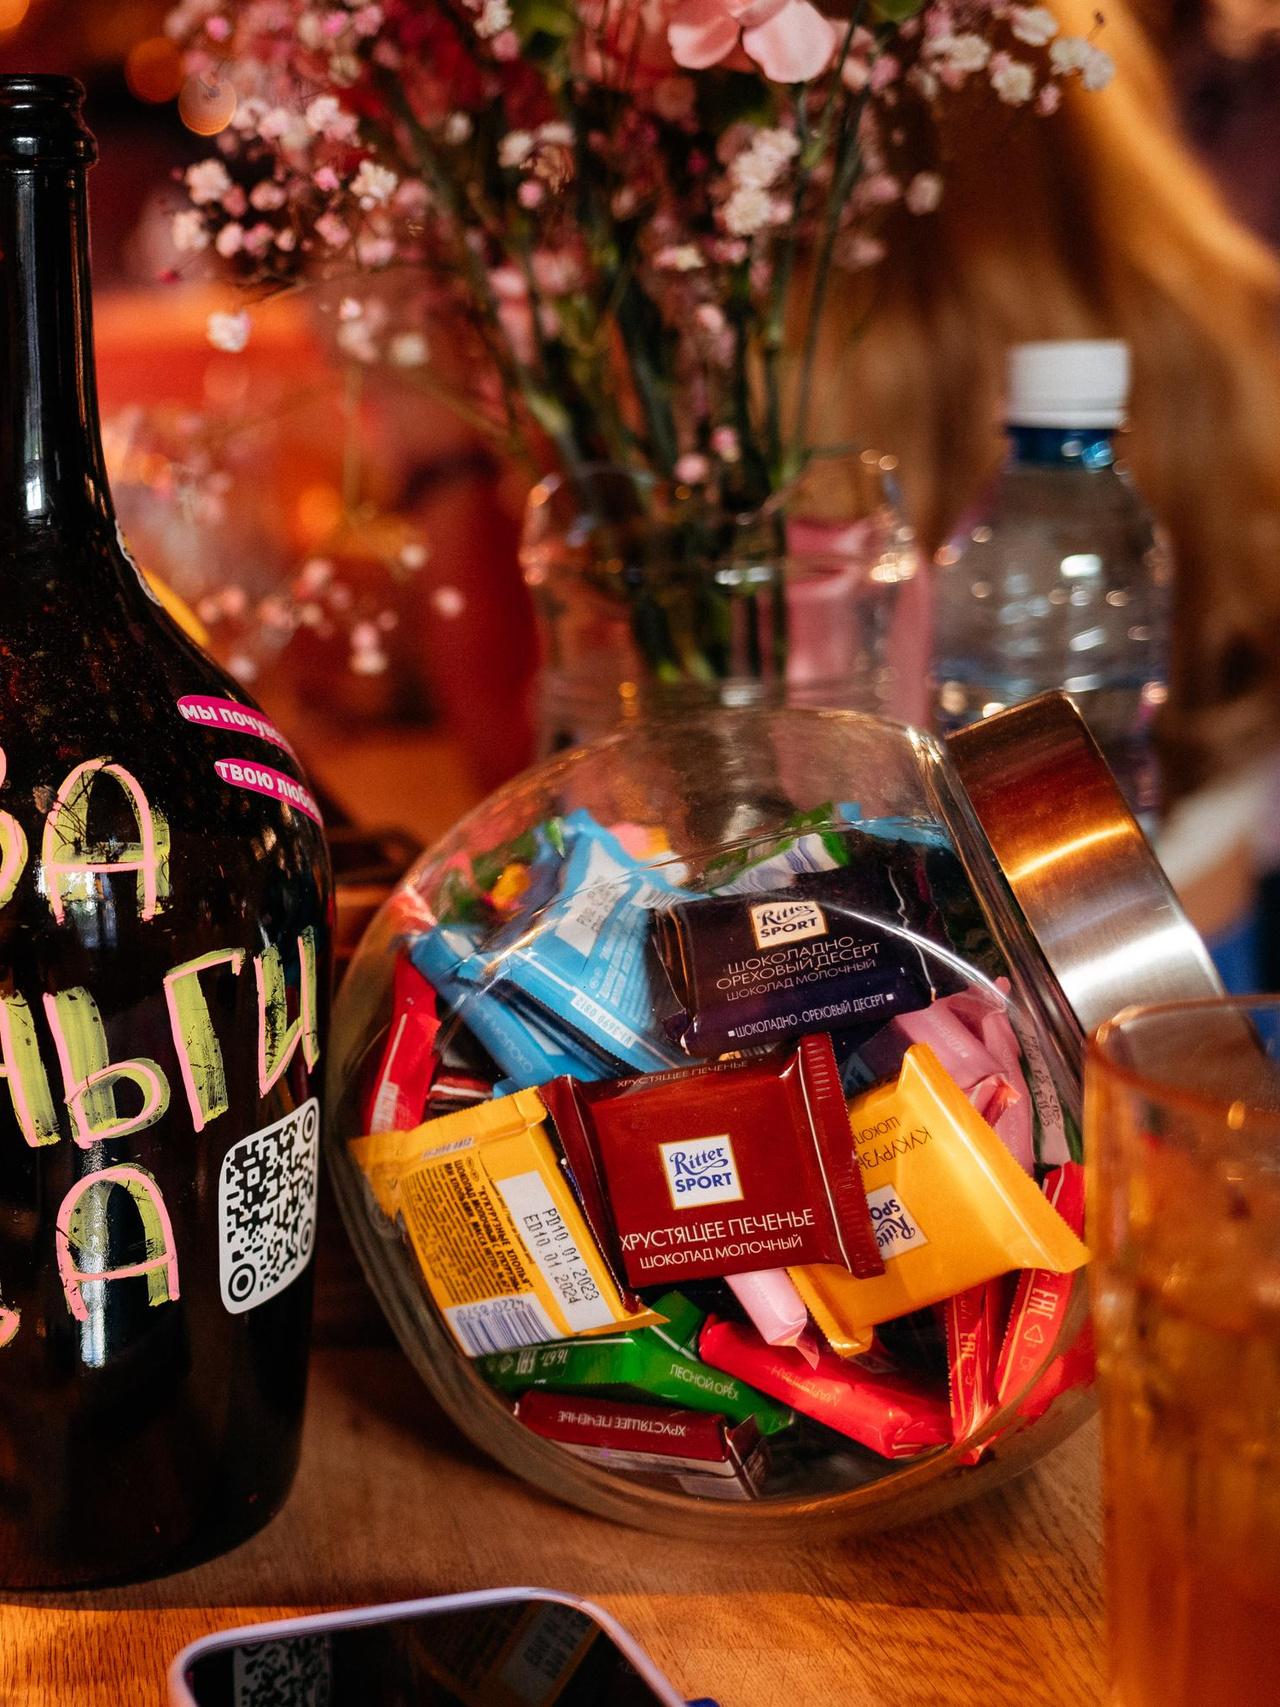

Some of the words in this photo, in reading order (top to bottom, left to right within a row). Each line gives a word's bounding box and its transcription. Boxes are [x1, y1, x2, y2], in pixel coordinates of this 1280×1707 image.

[757, 904, 814, 927] Ritter
[761, 917, 818, 938] SPORT
[716, 955, 814, 991] ОРЕХОВЫЙ
[816, 942, 880, 971] ДЕСЕРТ
[727, 977, 795, 1002] ШОКОЛАД
[796, 959, 876, 986] МОЛОЧНЫЙ
[853, 993, 885, 1014] ДЕСЕРТ
[617, 1069, 690, 1088] ХРУСТЯЩЕЕ
[691, 1060, 748, 1076] ПЕЧЕНЬЕ
[856, 1116, 901, 1147] ШОКОЛ
[669, 1147, 729, 1177] Ritter
[857, 1125, 933, 1170] КУКУРУЗН
[675, 1172, 732, 1193] SPORT
[618, 1220, 725, 1251] ХРУСТЯЩЕЕ
[728, 1208, 816, 1237] ПЕЧЕНЬЕ
[877, 1217, 916, 1248] Ritte
[640, 1250, 714, 1269] ШОКОЛАД
[716, 1234, 804, 1260] МОЛОЧНЫЙ
[670, 1363, 714, 1392] ЛЕСНОЙ
[714, 1380, 740, 1401] ОРЕХ
[557, 1410, 612, 1428] ПЕЧЕНЬЕ
[613, 1419, 686, 1437] ХРУСТЯЩЕЕ
